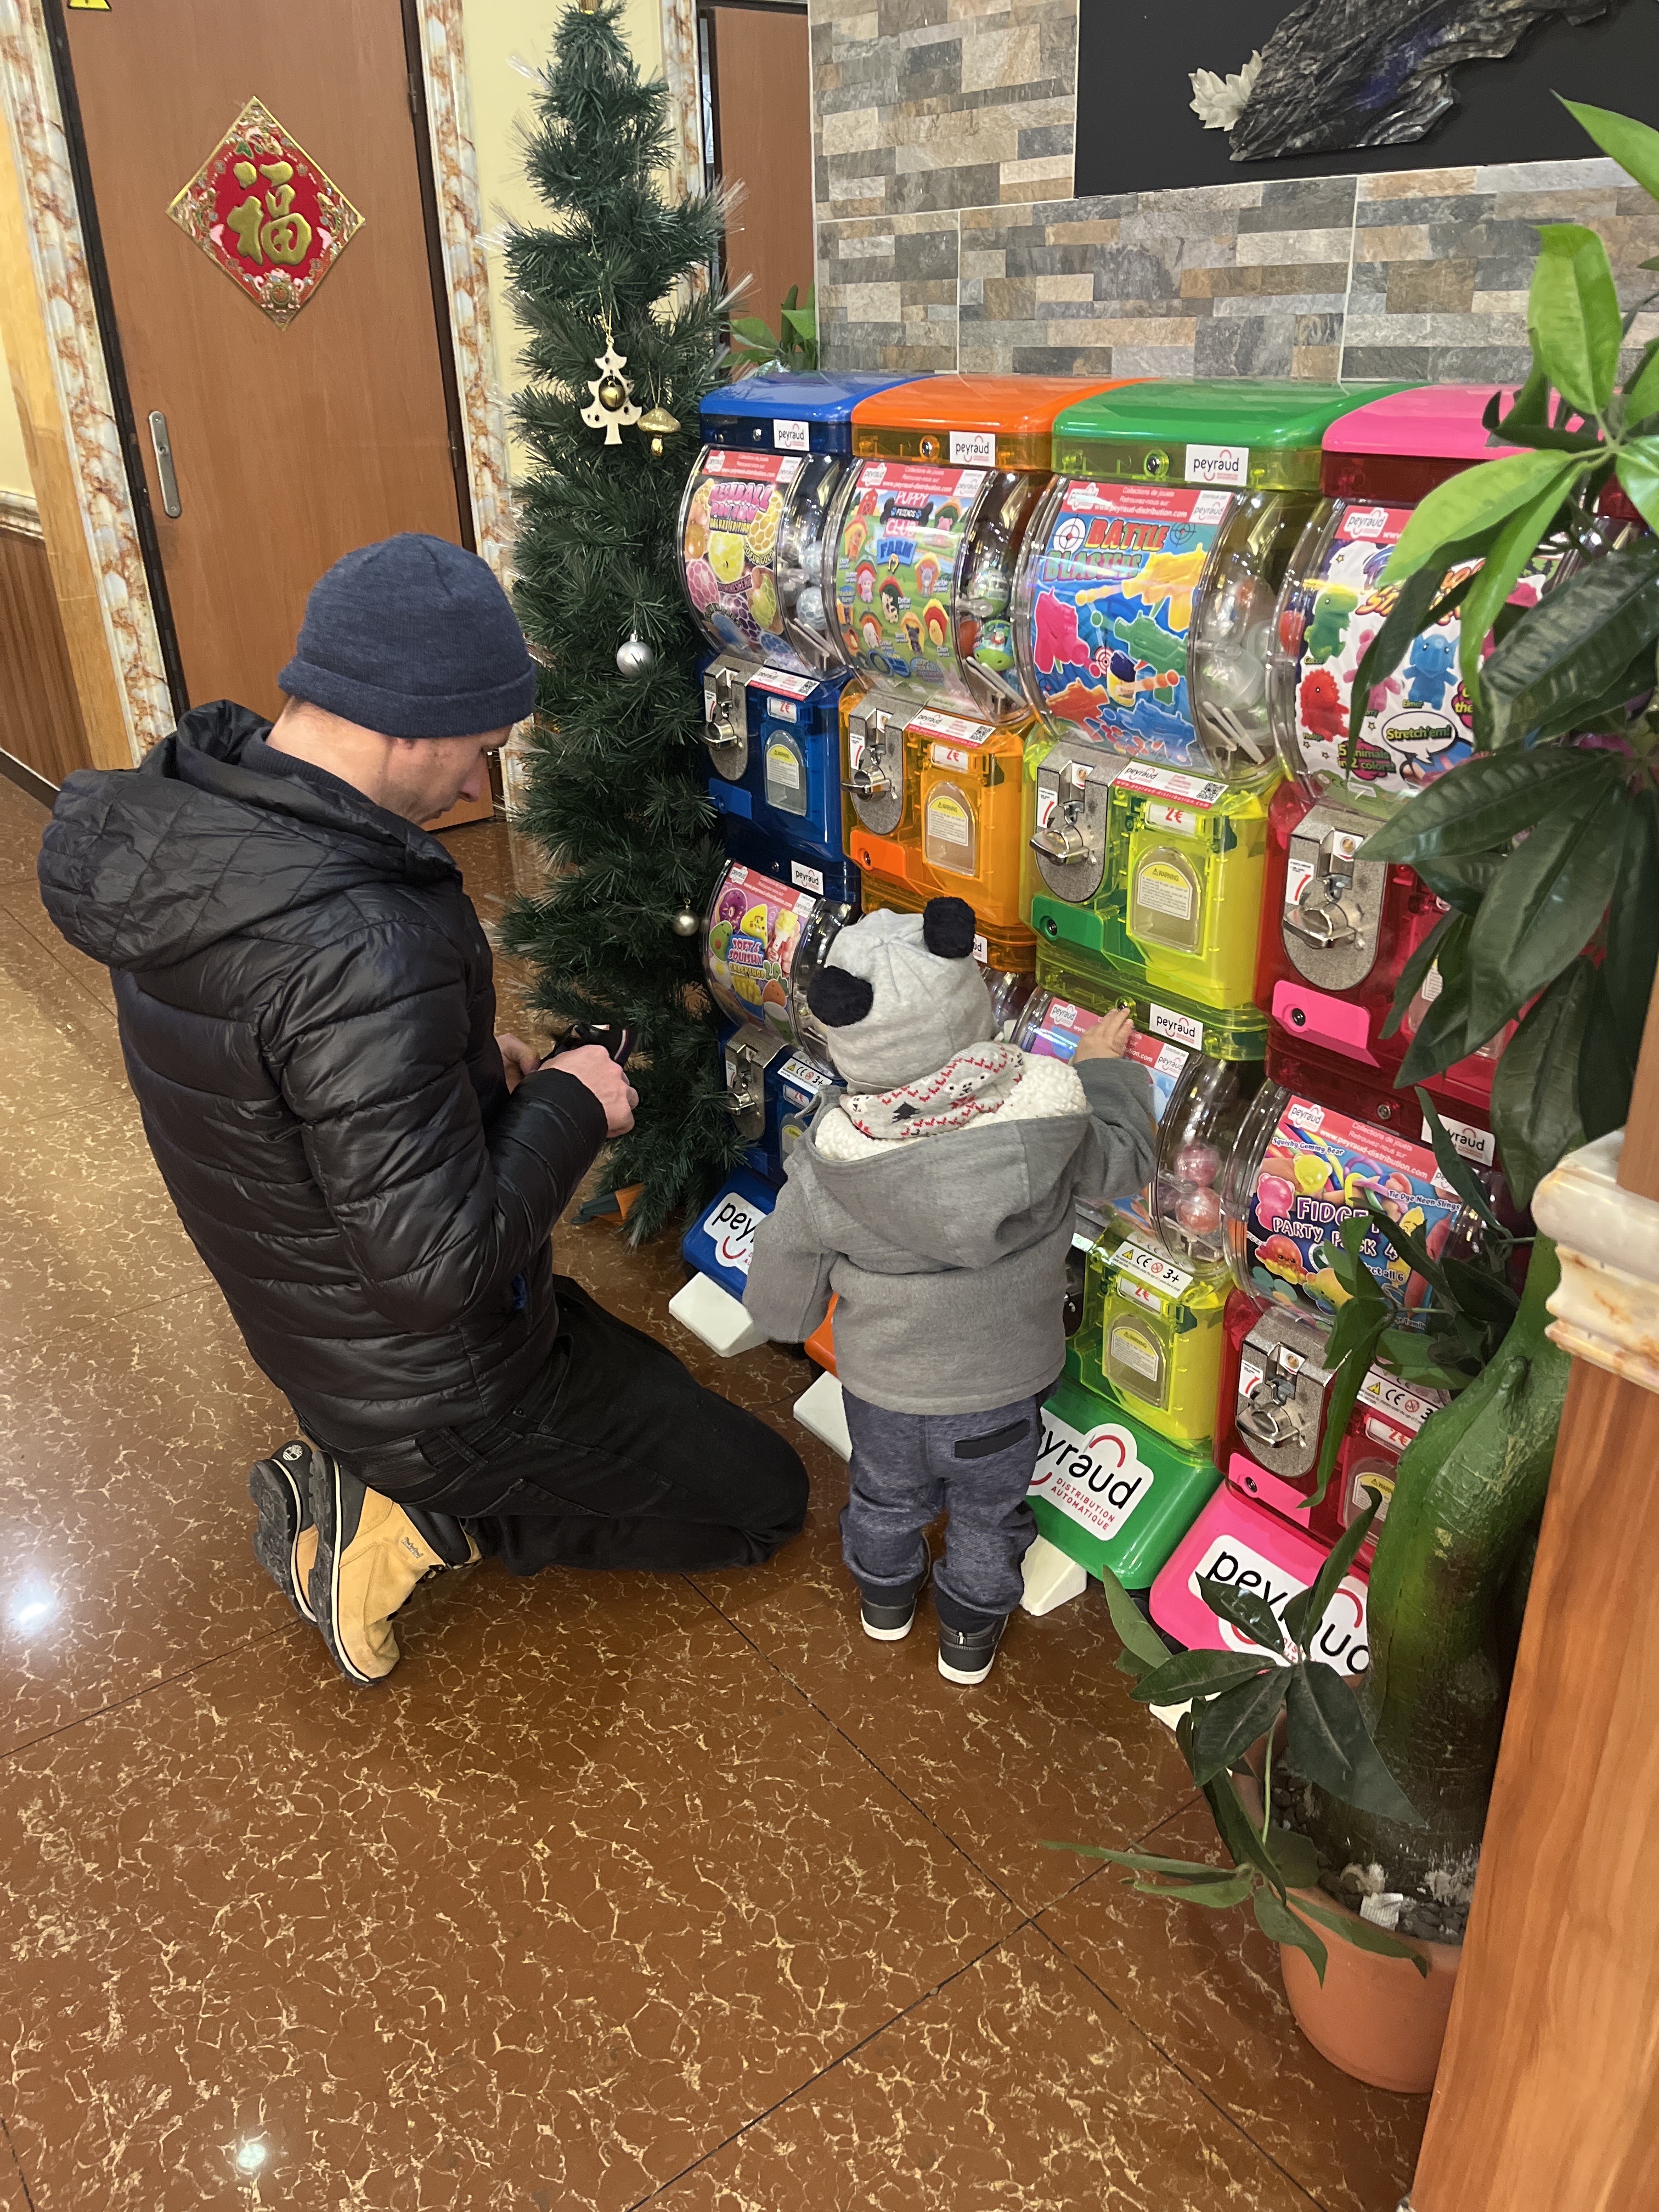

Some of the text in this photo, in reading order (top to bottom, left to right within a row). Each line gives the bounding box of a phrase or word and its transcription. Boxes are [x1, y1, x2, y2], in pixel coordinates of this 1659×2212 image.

[227, 160, 312, 266] 福
[778, 430, 804, 441] peyraud
[956, 442, 989, 455] peyraud
[1193, 458, 1239, 472] peyraud
[895, 491, 929, 507] PUPPY
[896, 509, 916, 518] FRIENDS
[1348, 514, 1386, 528] peyraud
[885, 520, 917, 537] CLUB
[1084, 518, 1170, 552] BATTLE
[881, 541, 913, 558] FARM
[1043, 550, 1142, 582] BLASTERS
[1339, 744, 1391, 759] 5 nimals
[1125, 767, 1159, 780] peyraud
[1165, 807, 1184, 823] 2€
[795, 870, 819, 885] peyraud
[1159, 870, 1179, 882] WARNING
[732, 938, 762, 953] SOFT &
[727, 948, 764, 966] SQUISHY
[1052, 1006, 1076, 1020] peyraud
[1156, 1016, 1195, 1037] peyraud
[1158, 1056, 1183, 1070] peyraud
[812, 1075, 823, 1086] 3+
[1290, 1107, 1323, 1124] peyraud
[1348, 1130, 1395, 1155] Retrouvez-nous
[1352, 1122, 1385, 1140] Collections
[1393, 1137, 1413, 1152] jouets
[1447, 1128, 1485, 1152] yraud
[1273, 1137, 1344, 1155] Squishy Gummy Bear
[1319, 1129, 1427, 1179] www.peyraud-distribution.com
[1389, 1190, 1399, 1199] Tie
[1417, 1196, 1435, 1205] Neon
[1437, 1200, 1461, 1211] Slings
[1272, 1217, 1324, 1243] PARTY
[1331, 1231, 1378, 1257] PK
[1136, 1255, 1179, 1283] CE 3+
[1383, 1269, 1396, 1280] all
[1397, 1272, 1404, 1283] 6
[1385, 1389, 1406, 1406] CE
[1037, 1426, 1142, 1509] yraud
[1050, 1486, 1110, 1531] AUTOMATIQUE
[1056, 1477, 1116, 1523] DISTRIBUTION
